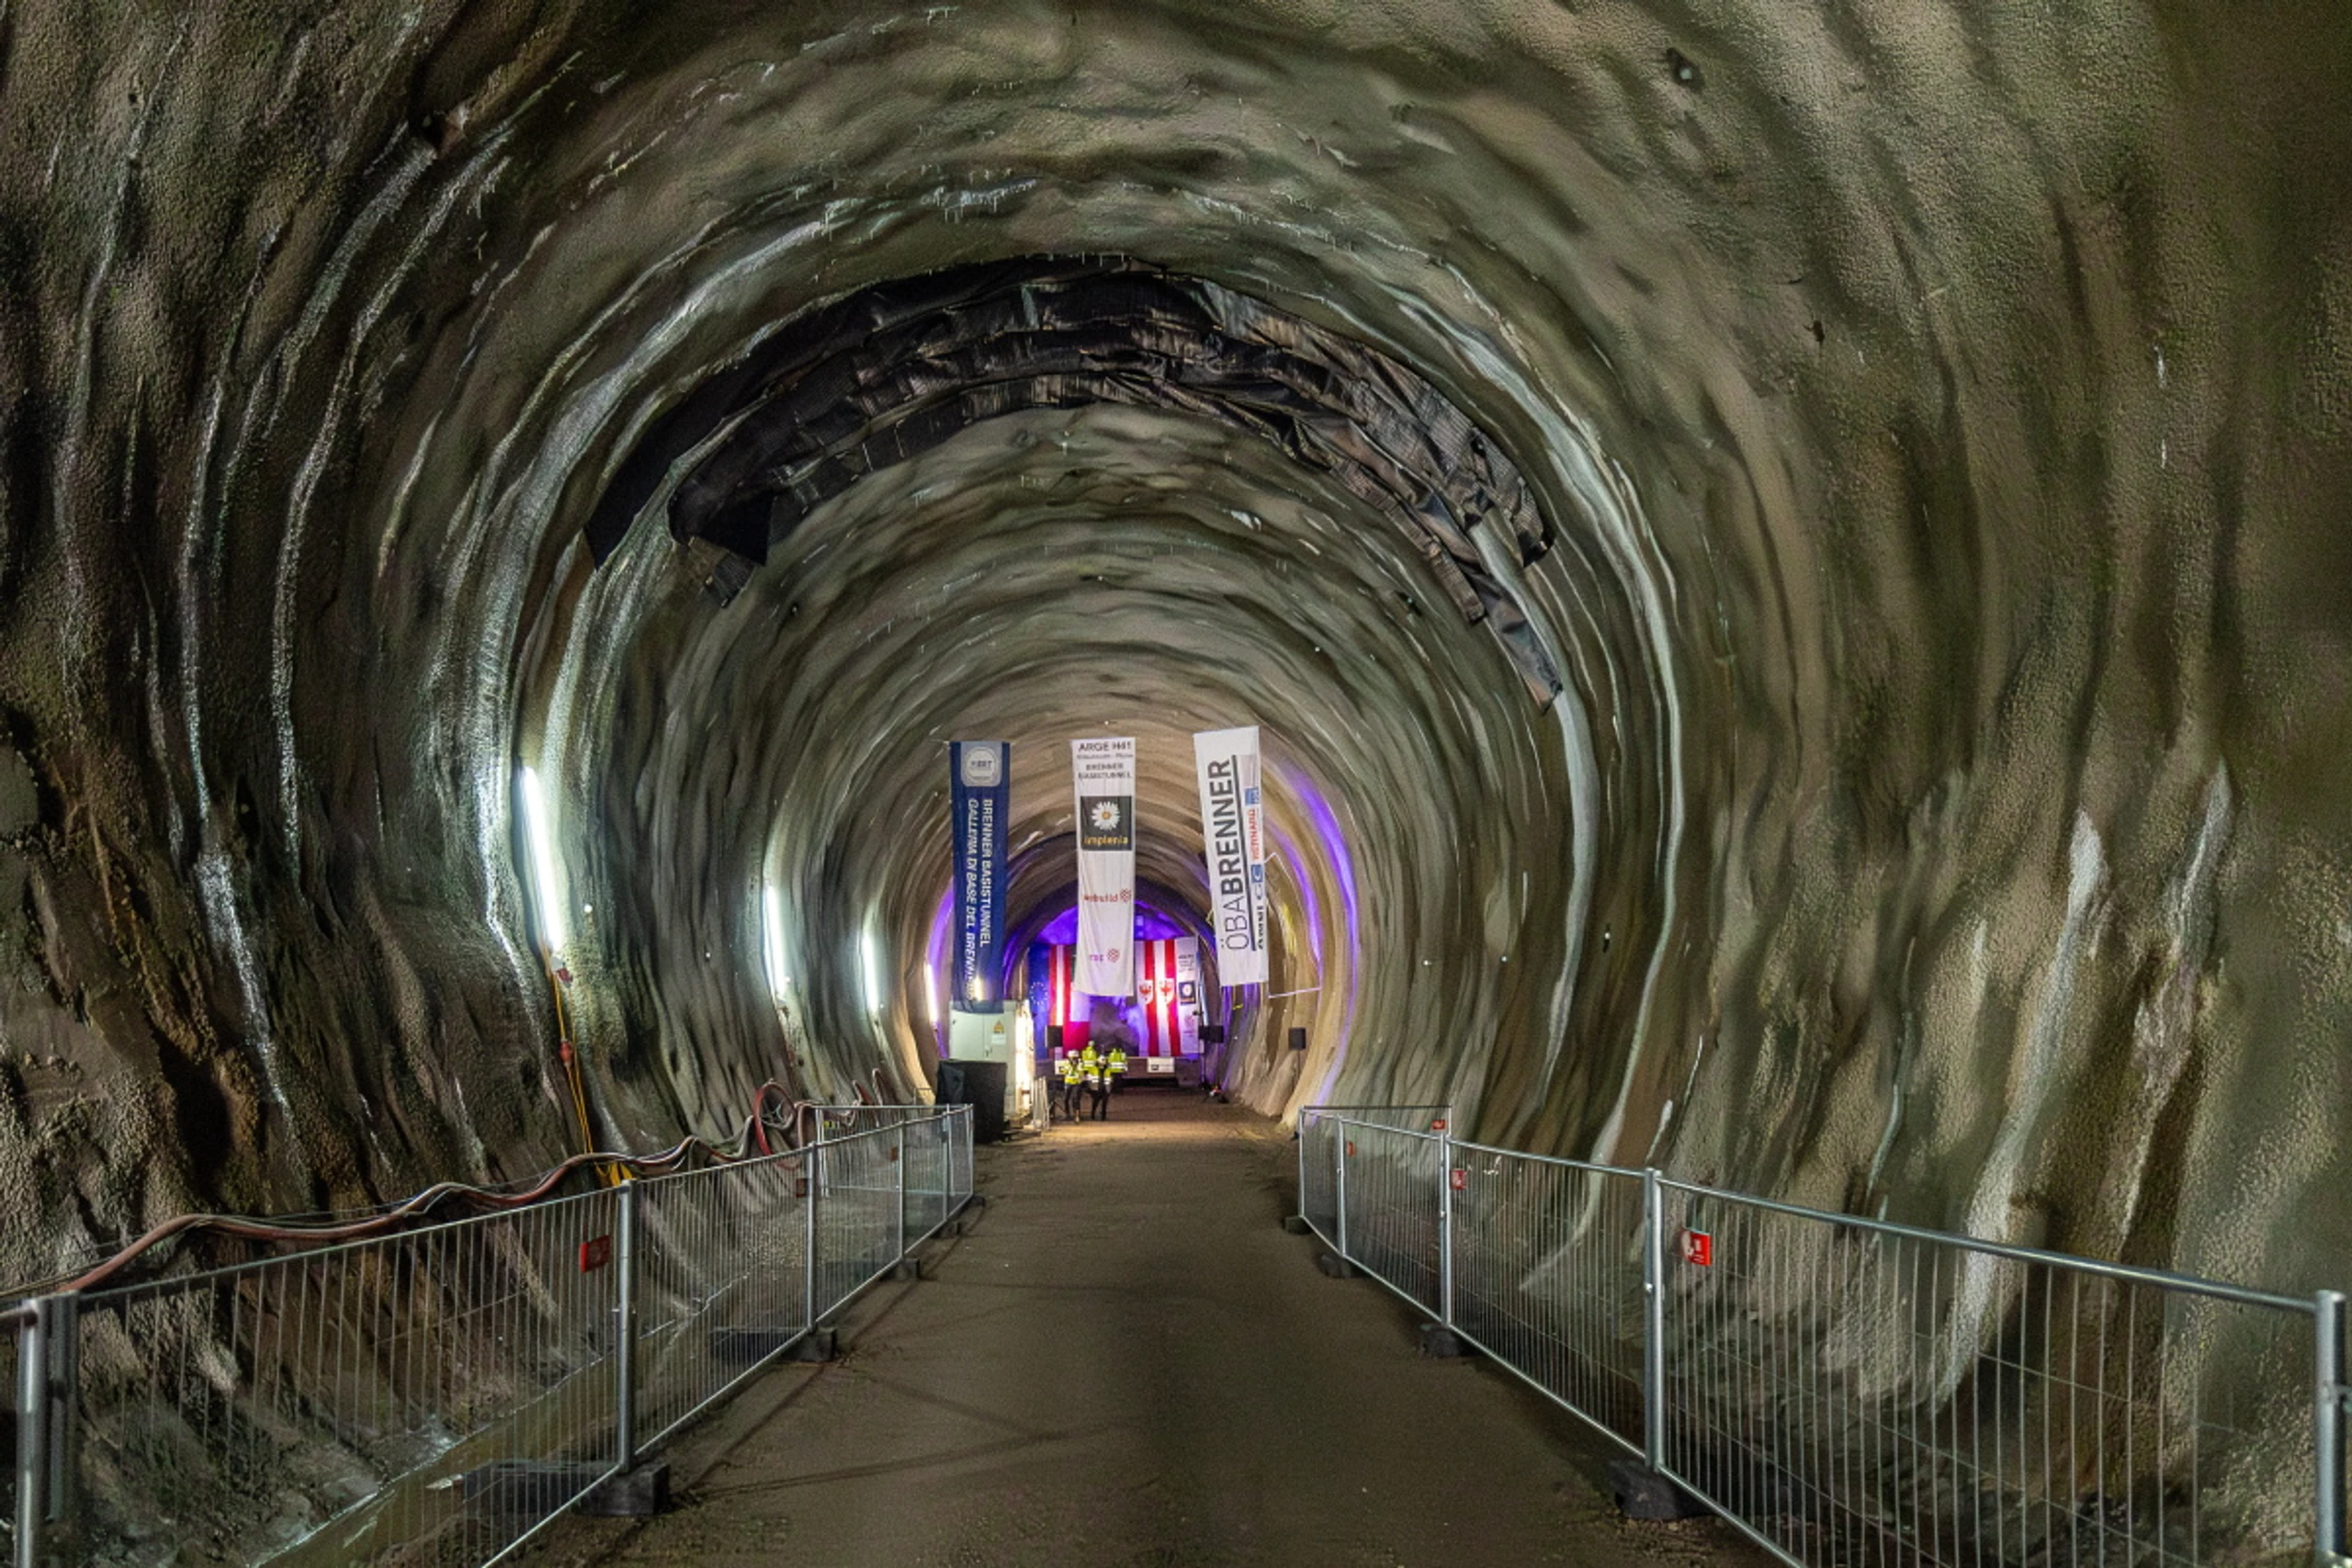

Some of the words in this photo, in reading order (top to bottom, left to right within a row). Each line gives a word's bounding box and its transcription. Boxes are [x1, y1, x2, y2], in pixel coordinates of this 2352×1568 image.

[1078, 740, 1109, 752] ARGE
[967, 798, 979, 854] GALLERIA
[981, 798, 993, 857] BRENNER
[1083, 835, 1128, 847] implenia
[967, 856, 978, 870] DI
[967, 873, 977, 904] BASE
[966, 906, 976, 929] DEL
[979, 860, 992, 948] BASISTUNNEL
